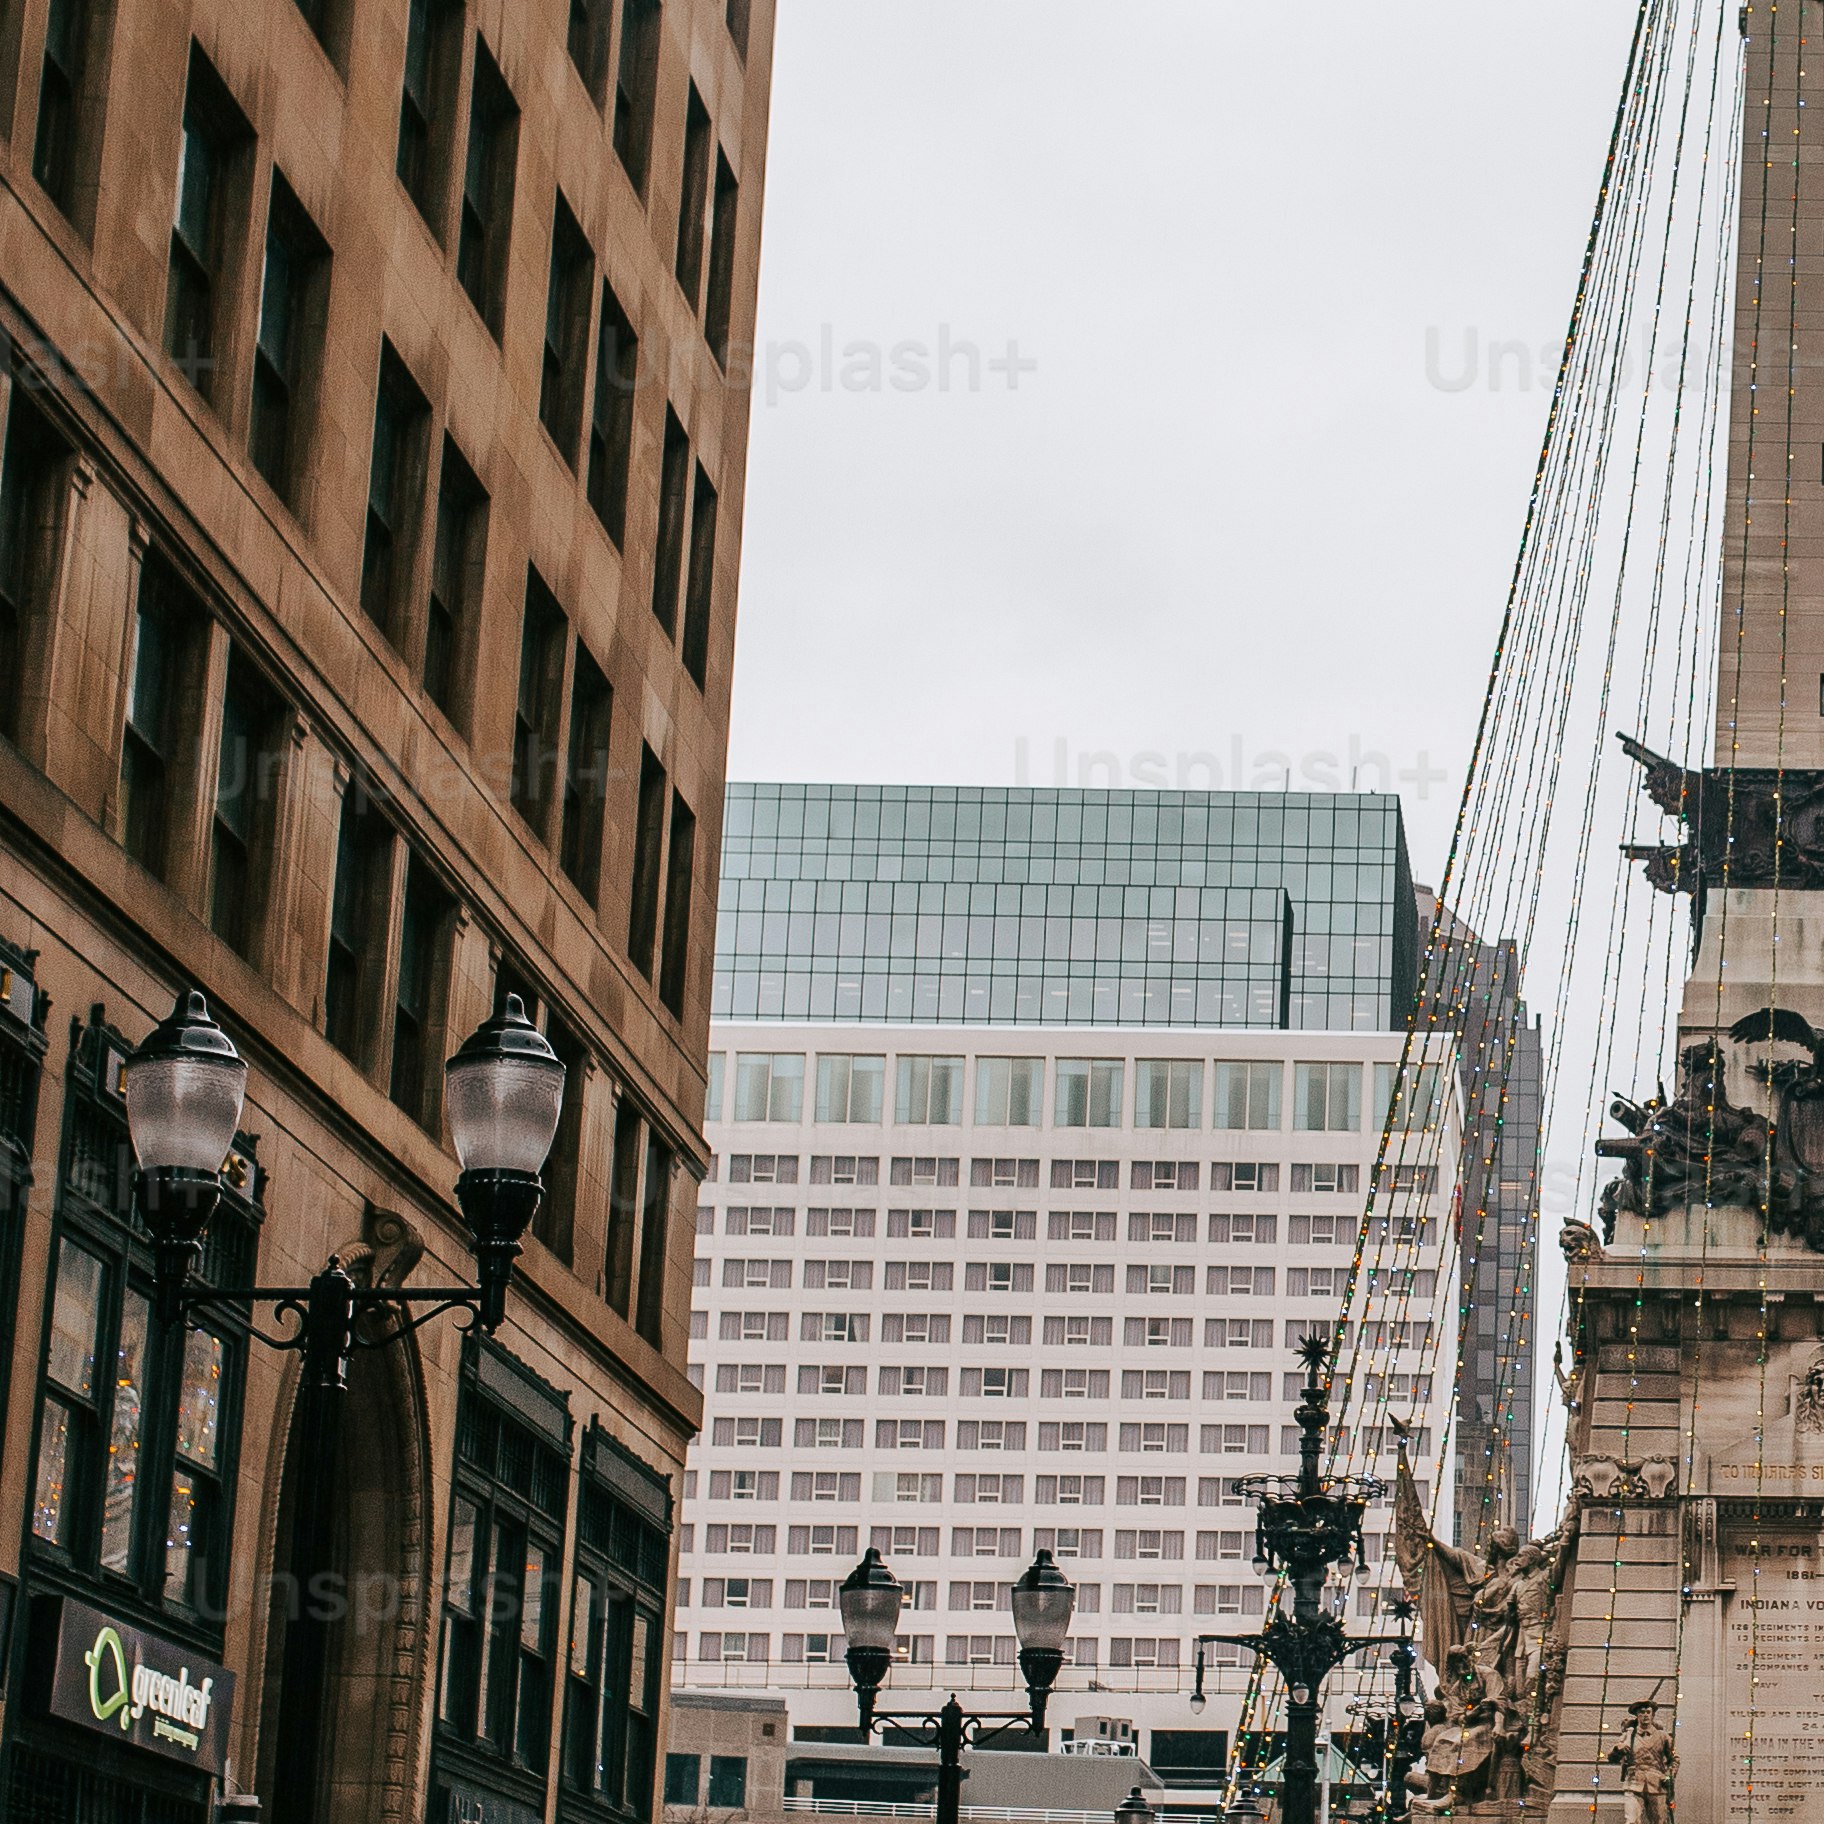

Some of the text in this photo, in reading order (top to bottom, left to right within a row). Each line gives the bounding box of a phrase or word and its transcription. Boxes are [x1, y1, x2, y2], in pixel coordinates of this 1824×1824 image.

[1777, 1545, 1812, 1557] FOR
[1741, 1600, 1799, 1611] INDIANA
[131, 1664, 213, 1729] greenleaf
